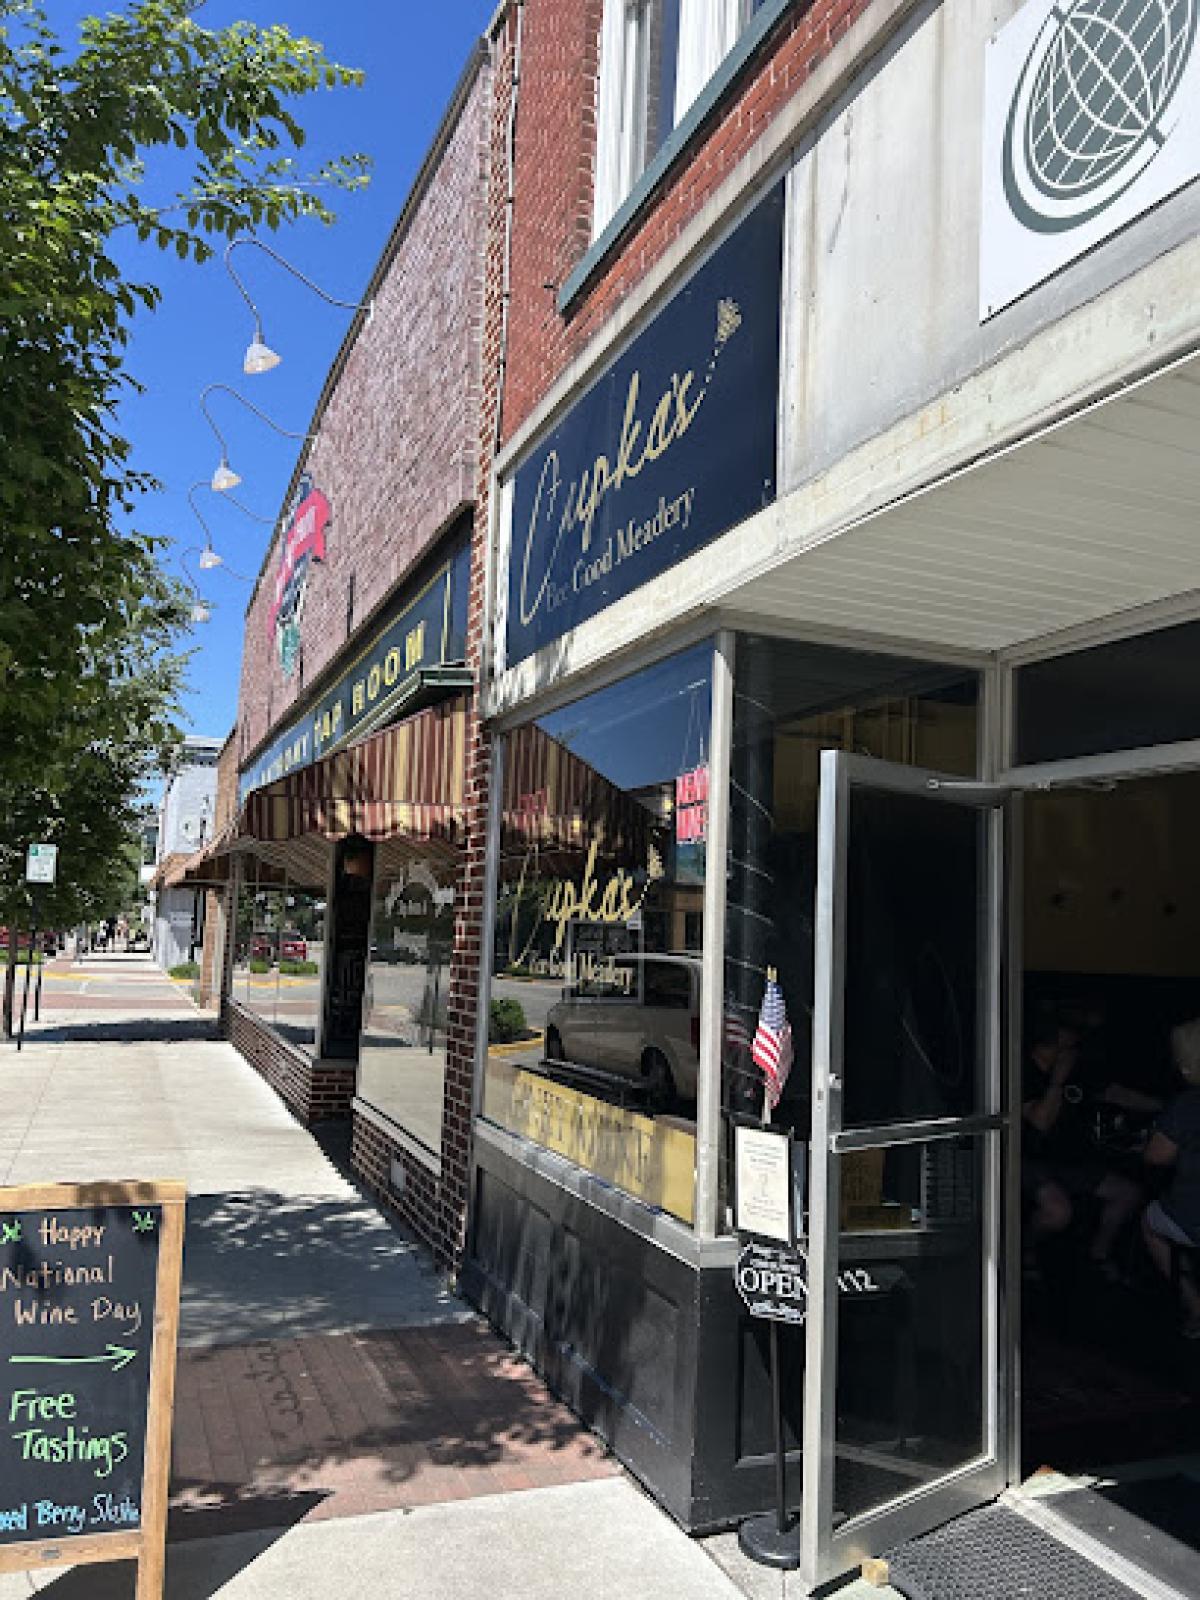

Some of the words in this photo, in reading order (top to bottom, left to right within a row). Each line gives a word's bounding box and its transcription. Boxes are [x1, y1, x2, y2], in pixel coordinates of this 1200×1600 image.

[573, 539, 612, 592] Good
[615, 488, 696, 564] Meadery
[353, 620, 424, 715] ROOM
[38, 1217, 106, 1250] Happy
[0, 1255, 114, 1292] National
[740, 1267, 809, 1300] OPEN
[14, 1299, 80, 1326] Wine
[91, 1296, 142, 1336] Day
[9, 1389, 77, 1422] Free
[12, 1426, 128, 1478] Tastings
